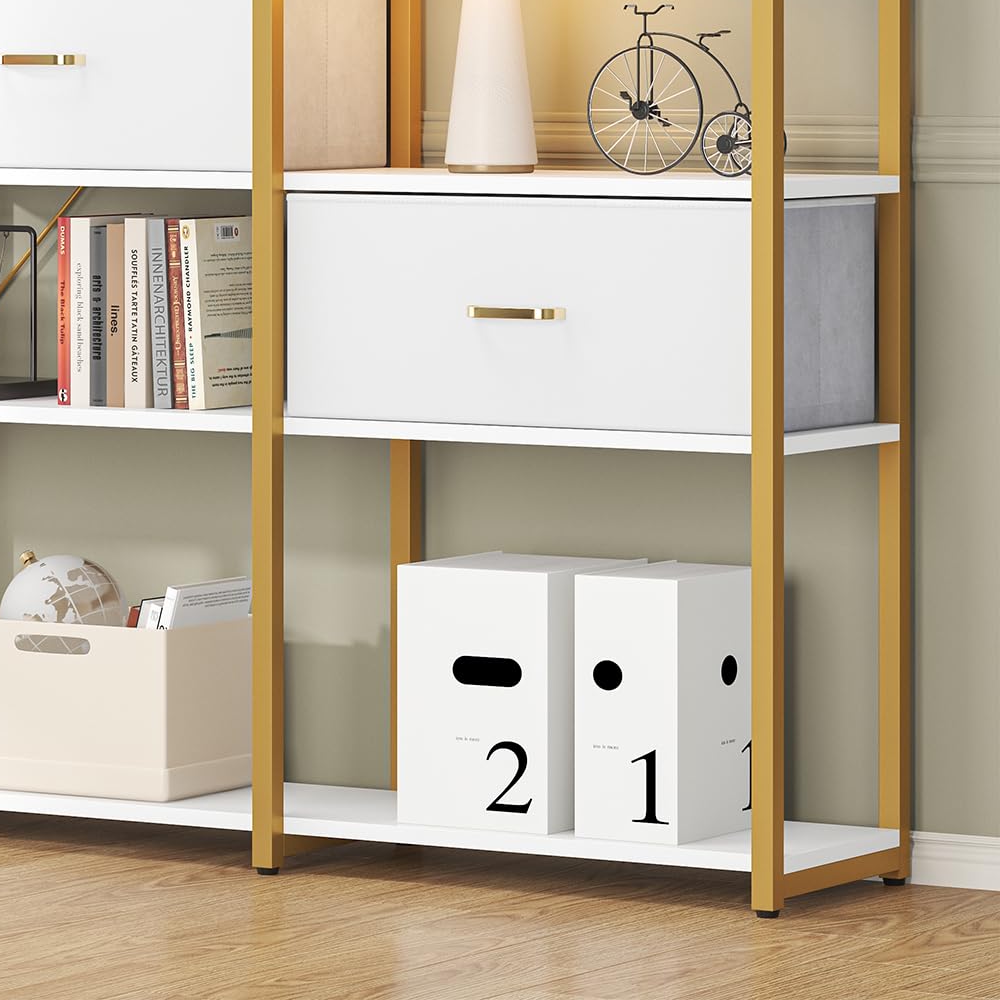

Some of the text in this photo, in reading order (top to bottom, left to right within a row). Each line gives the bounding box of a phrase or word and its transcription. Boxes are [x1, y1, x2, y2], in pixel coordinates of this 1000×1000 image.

[92, 275, 102, 292] arts
[92, 307, 102, 360] architecture
[110, 304, 120, 336] lines.
[151, 248, 168, 396] INNENARCHITEKTUR
[131, 345, 140, 383] GÂTEAUX
[486, 741, 532, 814] 2
[630, 750, 670, 825] 1
